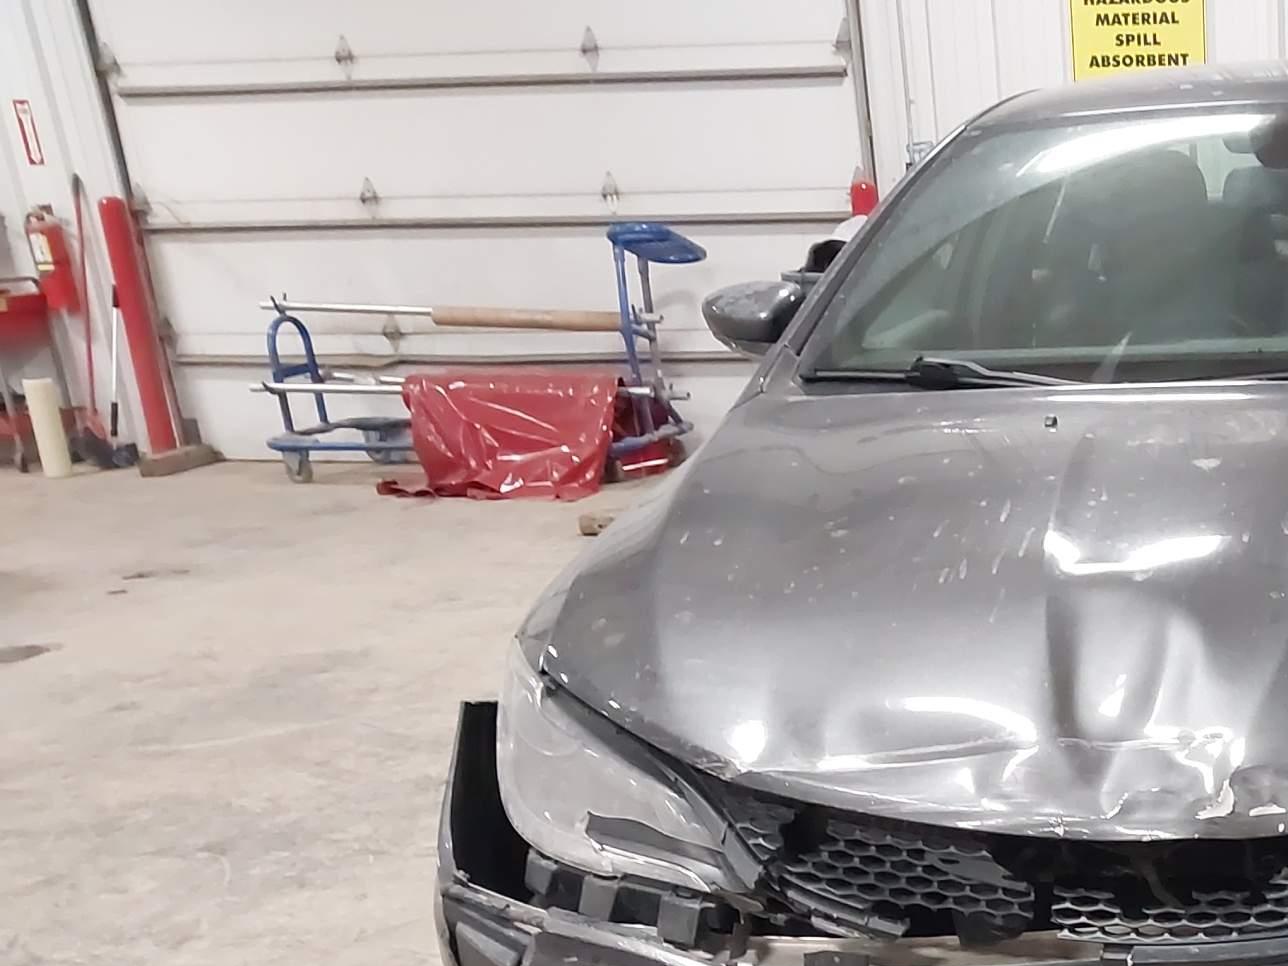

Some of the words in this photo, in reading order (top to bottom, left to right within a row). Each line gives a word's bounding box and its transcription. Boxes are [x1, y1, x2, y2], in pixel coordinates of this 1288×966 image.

[1095, 11, 1180, 27] MATERIAL
[1115, 33, 1161, 47] SPILL
[1089, 53, 1189, 68] ABSORBENT
